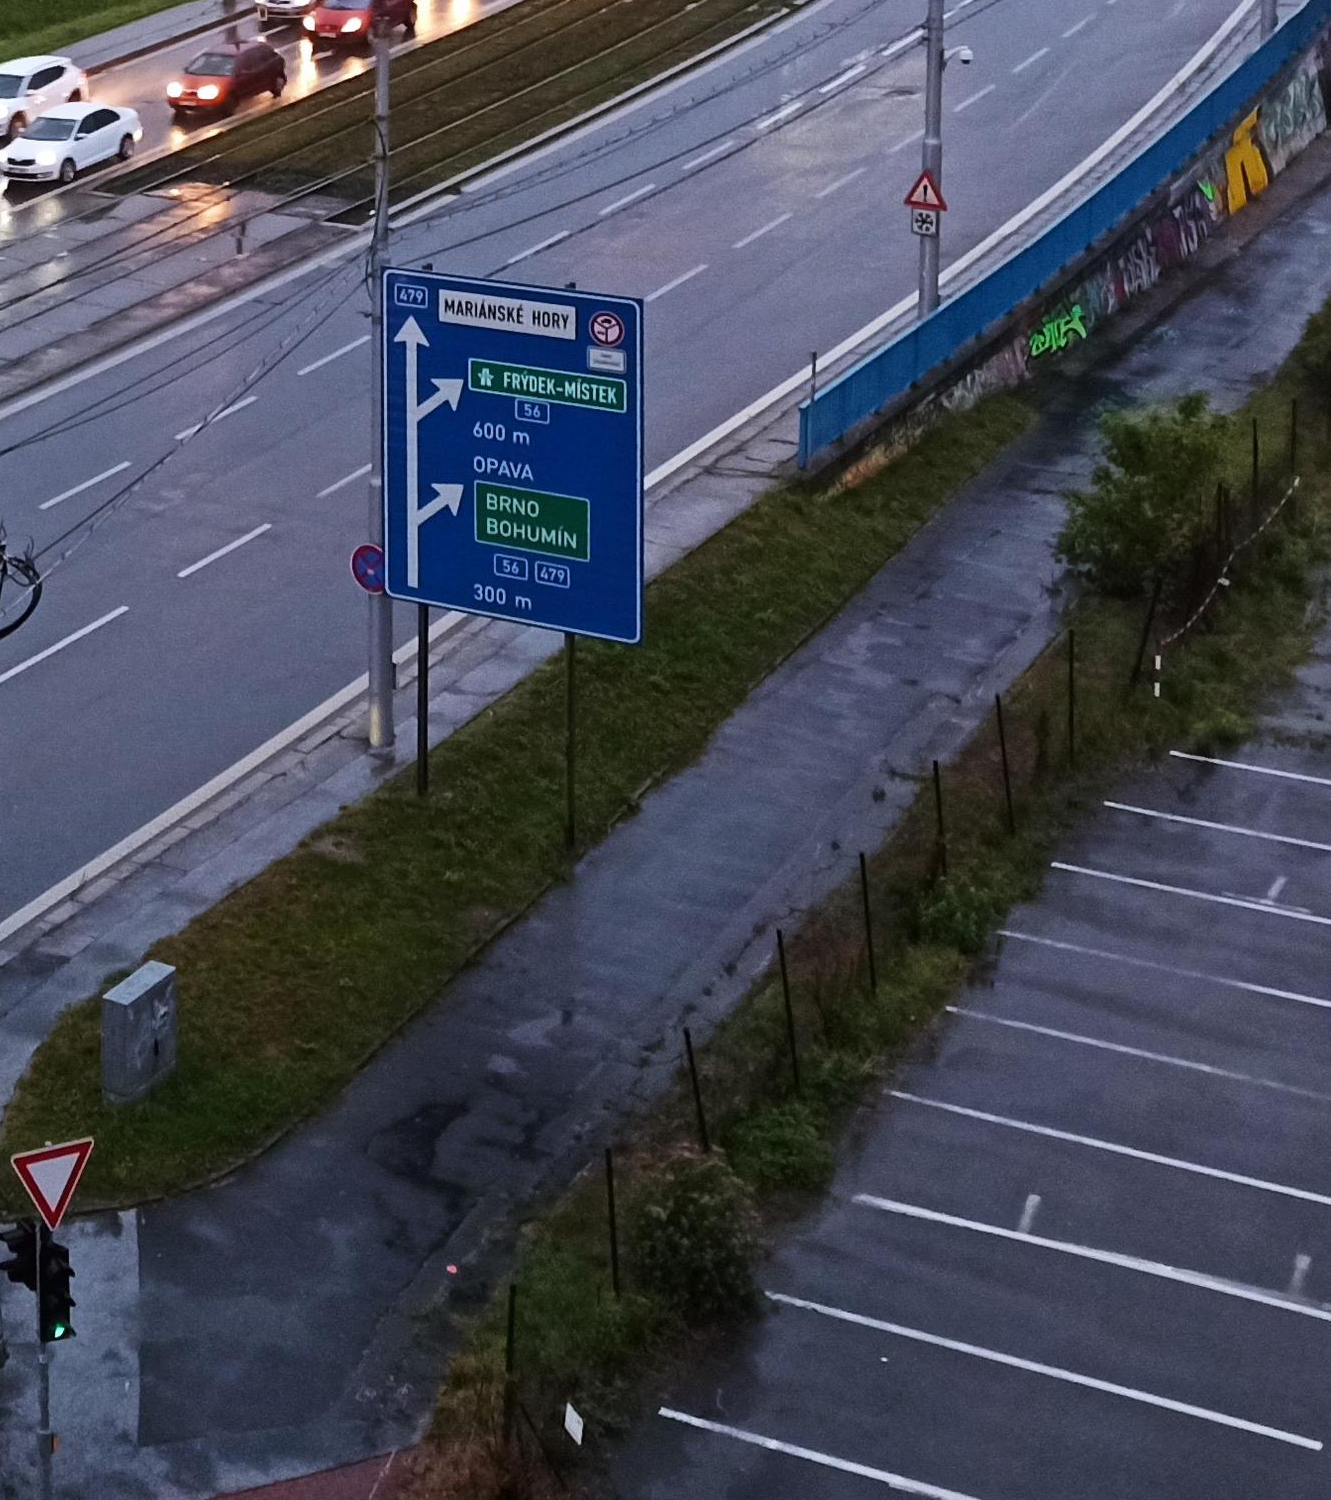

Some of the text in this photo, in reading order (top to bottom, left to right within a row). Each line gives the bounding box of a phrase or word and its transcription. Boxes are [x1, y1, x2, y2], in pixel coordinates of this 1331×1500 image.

[399, 287, 424, 304] 479
[443, 297, 570, 330] MARIÁNSKÉ HORY
[503, 367, 617, 405] FRÝDEK-MÍSTEK
[524, 403, 541, 418] 56
[472, 421, 530, 445] 600 m
[473, 456, 534, 481] OPAVA
[487, 493, 540, 518] BRNO
[487, 518, 577, 549] BOHUMÍN
[502, 559, 565, 583] 56 479
[473, 583, 532, 610] 300 m
